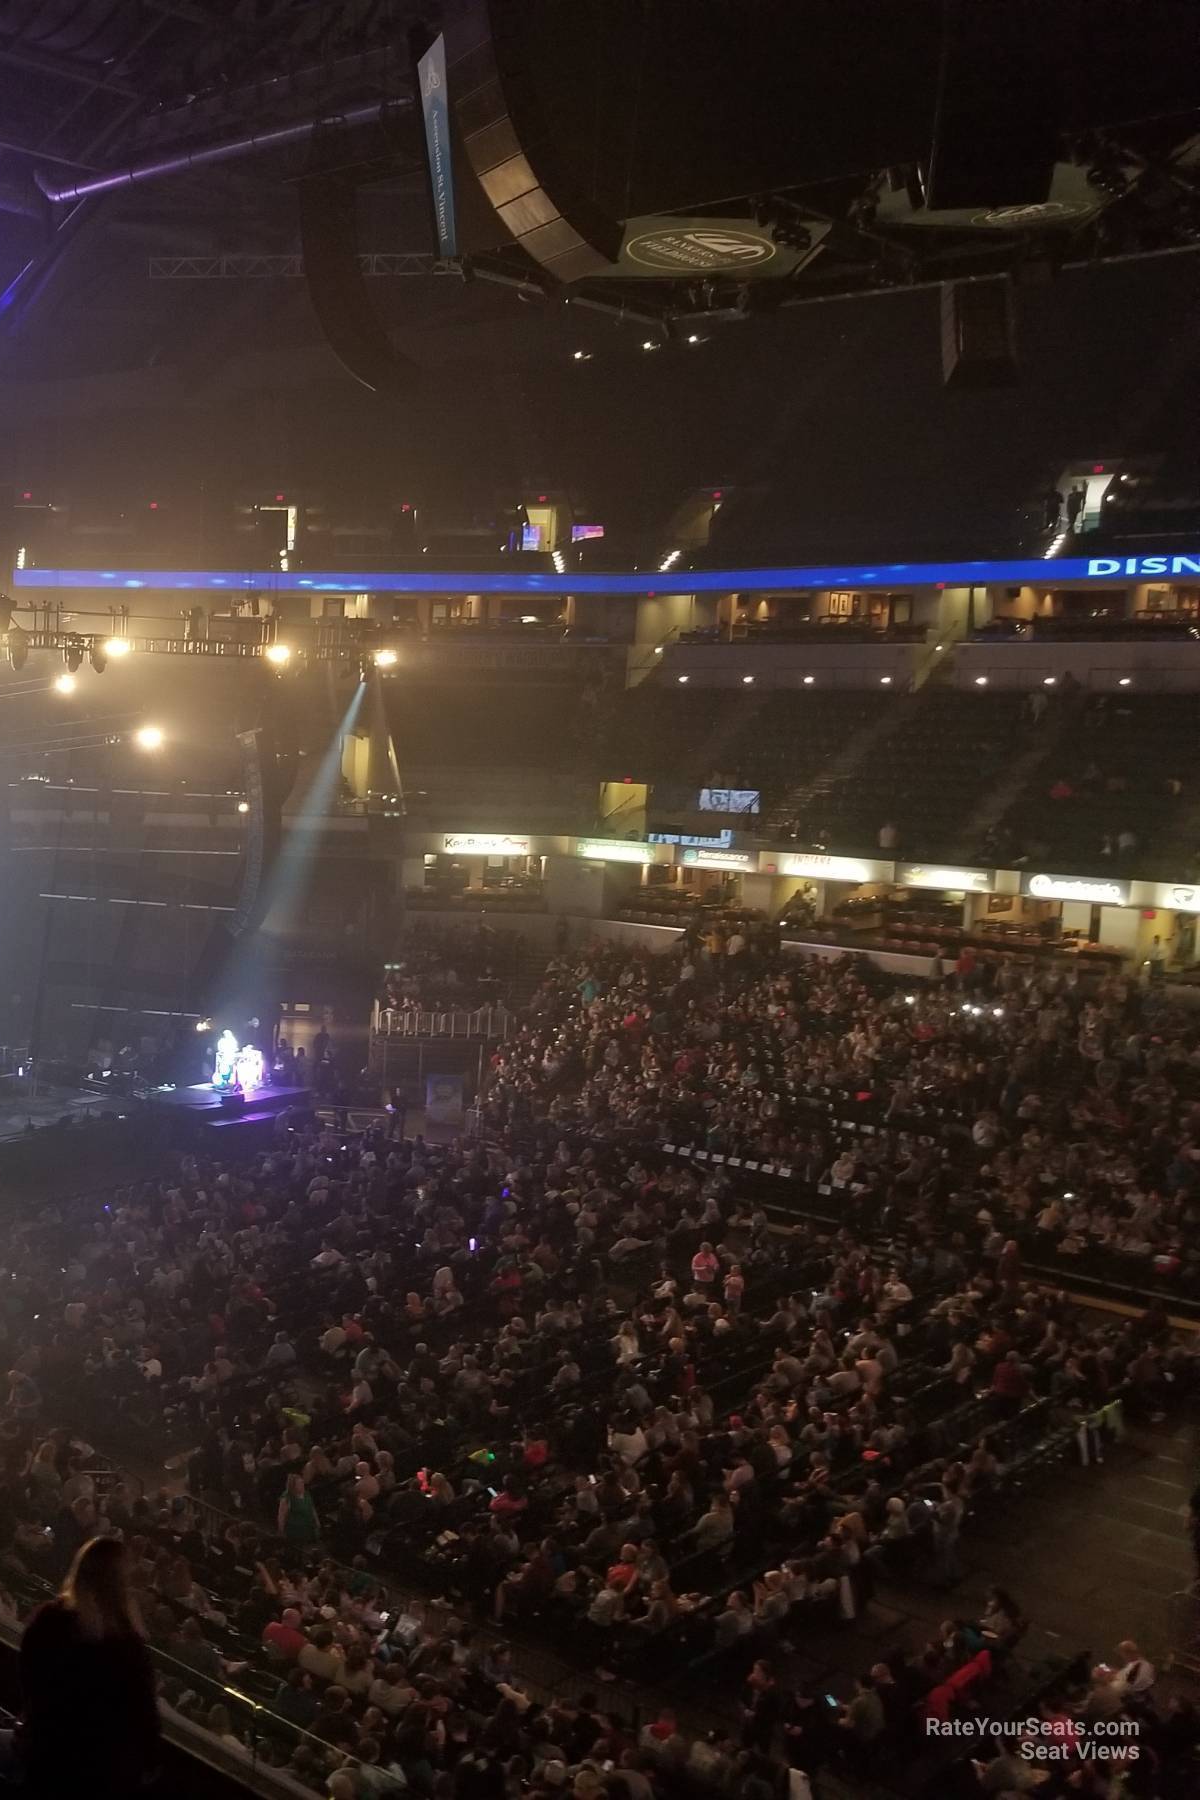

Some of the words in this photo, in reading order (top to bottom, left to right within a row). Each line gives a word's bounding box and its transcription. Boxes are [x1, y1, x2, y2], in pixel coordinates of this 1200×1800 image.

[431, 110, 442, 172] Ascension
[438, 192, 449, 241] Vincent
[1088, 556, 1200, 576] DISN
